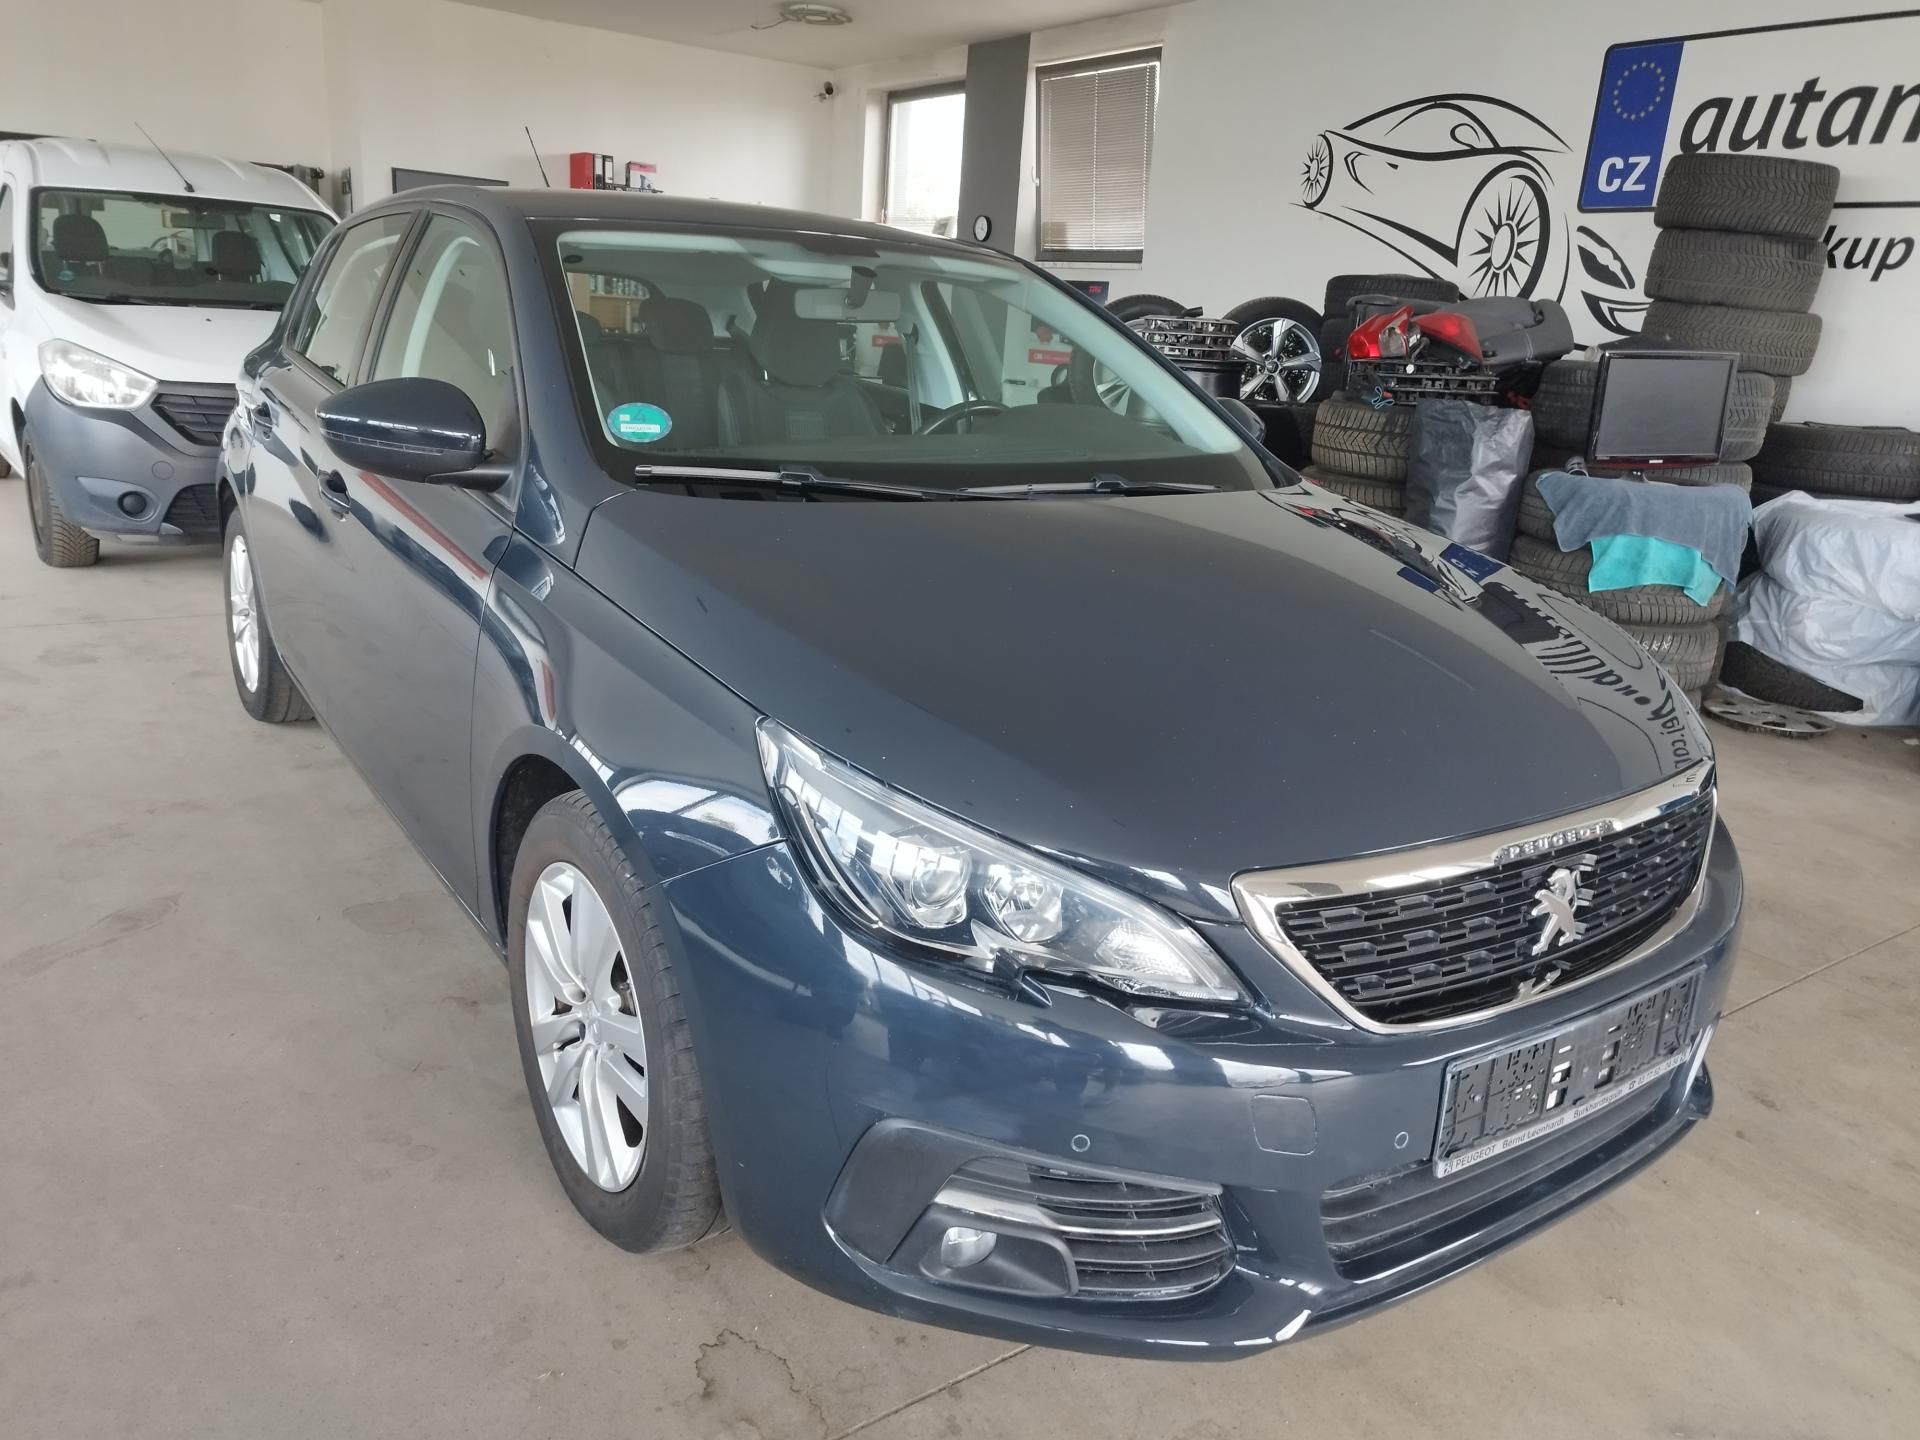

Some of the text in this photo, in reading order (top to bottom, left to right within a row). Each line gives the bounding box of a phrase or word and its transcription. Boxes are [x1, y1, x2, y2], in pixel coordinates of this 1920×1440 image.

[1598, 156, 1651, 193] CZ
[1508, 822, 1605, 859] PEUGEOT
[1455, 1145, 1496, 1169] PEUGEOT
[1502, 1132, 1525, 1149] Bernd
